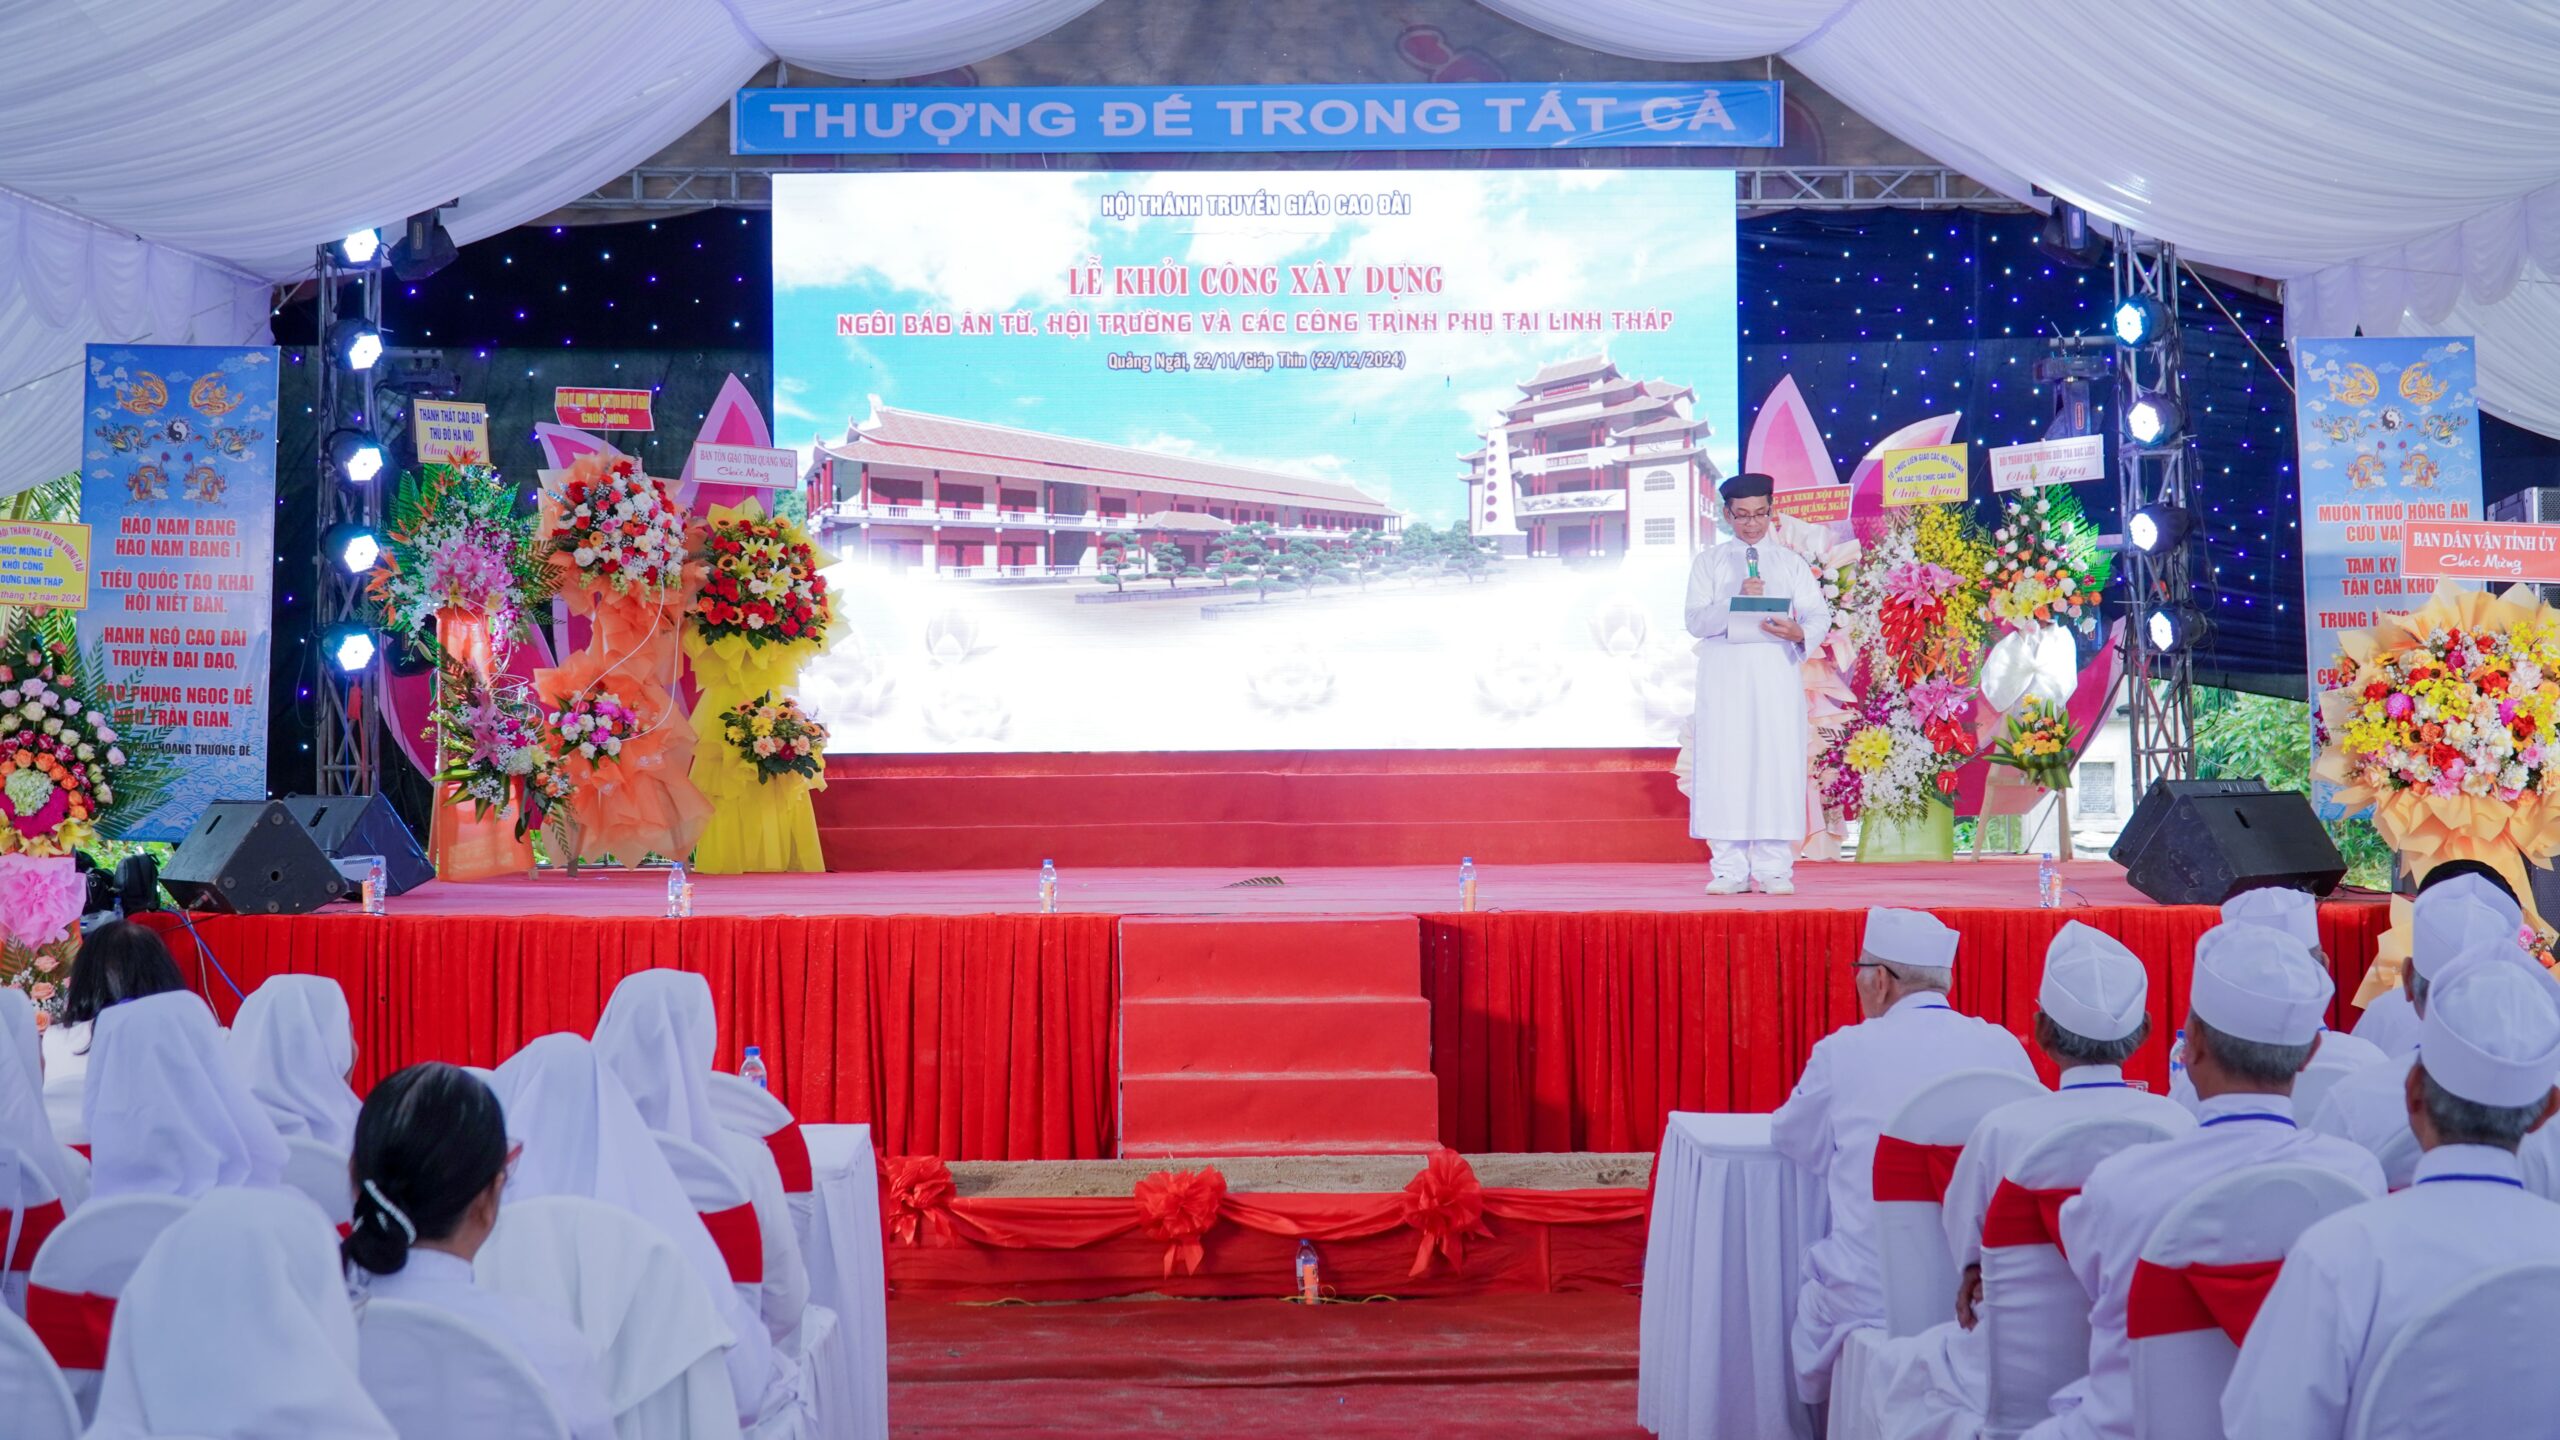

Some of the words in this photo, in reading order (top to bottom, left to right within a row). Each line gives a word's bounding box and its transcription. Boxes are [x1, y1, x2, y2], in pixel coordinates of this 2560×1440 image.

[769, 101, 1077, 146] THƯỢNG
[1098, 93, 1193, 137] ĐẾ
[1216, 99, 1462, 136] TRONG
[1485, 90, 1617, 133] TẤT
[1640, 90, 1737, 132] CẢ
[1101, 190, 1136, 221] HỘI
[1139, 190, 1202, 217] THÁNH
[1206, 188, 1281, 216] TRUYỀN
[1284, 190, 1331, 216] GIÁO
[1334, 193, 1374, 216] CAO
[1377, 190, 1412, 216] ĐÀI
[1068, 254, 1103, 296] LỄ
[1114, 257, 1189, 296] KHỞI
[1200, 260, 1279, 296] CÔNG
[1290, 259, 1353, 296] XÂY
[1365, 261, 1444, 301] DỰNG
[837, 310, 895, 336] NGÔI
[903, 309, 952, 335] BÁO
[960, 310, 994, 335] ÂN
[1046, 309, 1090, 339] HỘI
[1201, 308, 1233, 334] VÀ
[1241, 308, 1287, 333] CÁC
[1295, 308, 1359, 333] CÔNG
[1447, 311, 1495, 337] PHỤ
[1503, 310, 1540, 337] TẠI
[1548, 310, 1602, 333] LINH
[1612, 307, 1674, 332] THÁP
[1107, 350, 1151, 372] Quảng
[1193, 350, 1274, 371] 22/11/Giáp
[1277, 351, 1307, 369] Thìn
[1309, 350, 1406, 370] (22/12/2024)
[2319, 502, 2361, 521] MUÔN
[2451, 500, 2469, 519] ÂN
[156, 518, 190, 535] NAM
[195, 519, 236, 536] BANG
[151, 539, 184, 556] NAM
[189, 540, 231, 557] BANG
[2413, 532, 2440, 547] BAN
[2443, 530, 2472, 548] DÂN
[2473, 531, 2501, 552] VẬN
[2346, 557, 2375, 574] TAM
[138, 567, 179, 590] QUỐC
[217, 574, 255, 591] KHAI
[61, 593, 81, 603] 2024
[125, 591, 150, 614] HỘI
[2319, 611, 2368, 629] TRUNG
[104, 626, 145, 647] HẠNH
[185, 628, 216, 646] CAO
[221, 627, 247, 647] ĐÀI
[173, 651, 199, 671] ĐẠI
[187, 686, 229, 707] NGỌC
[193, 710, 233, 728] GIAN.
